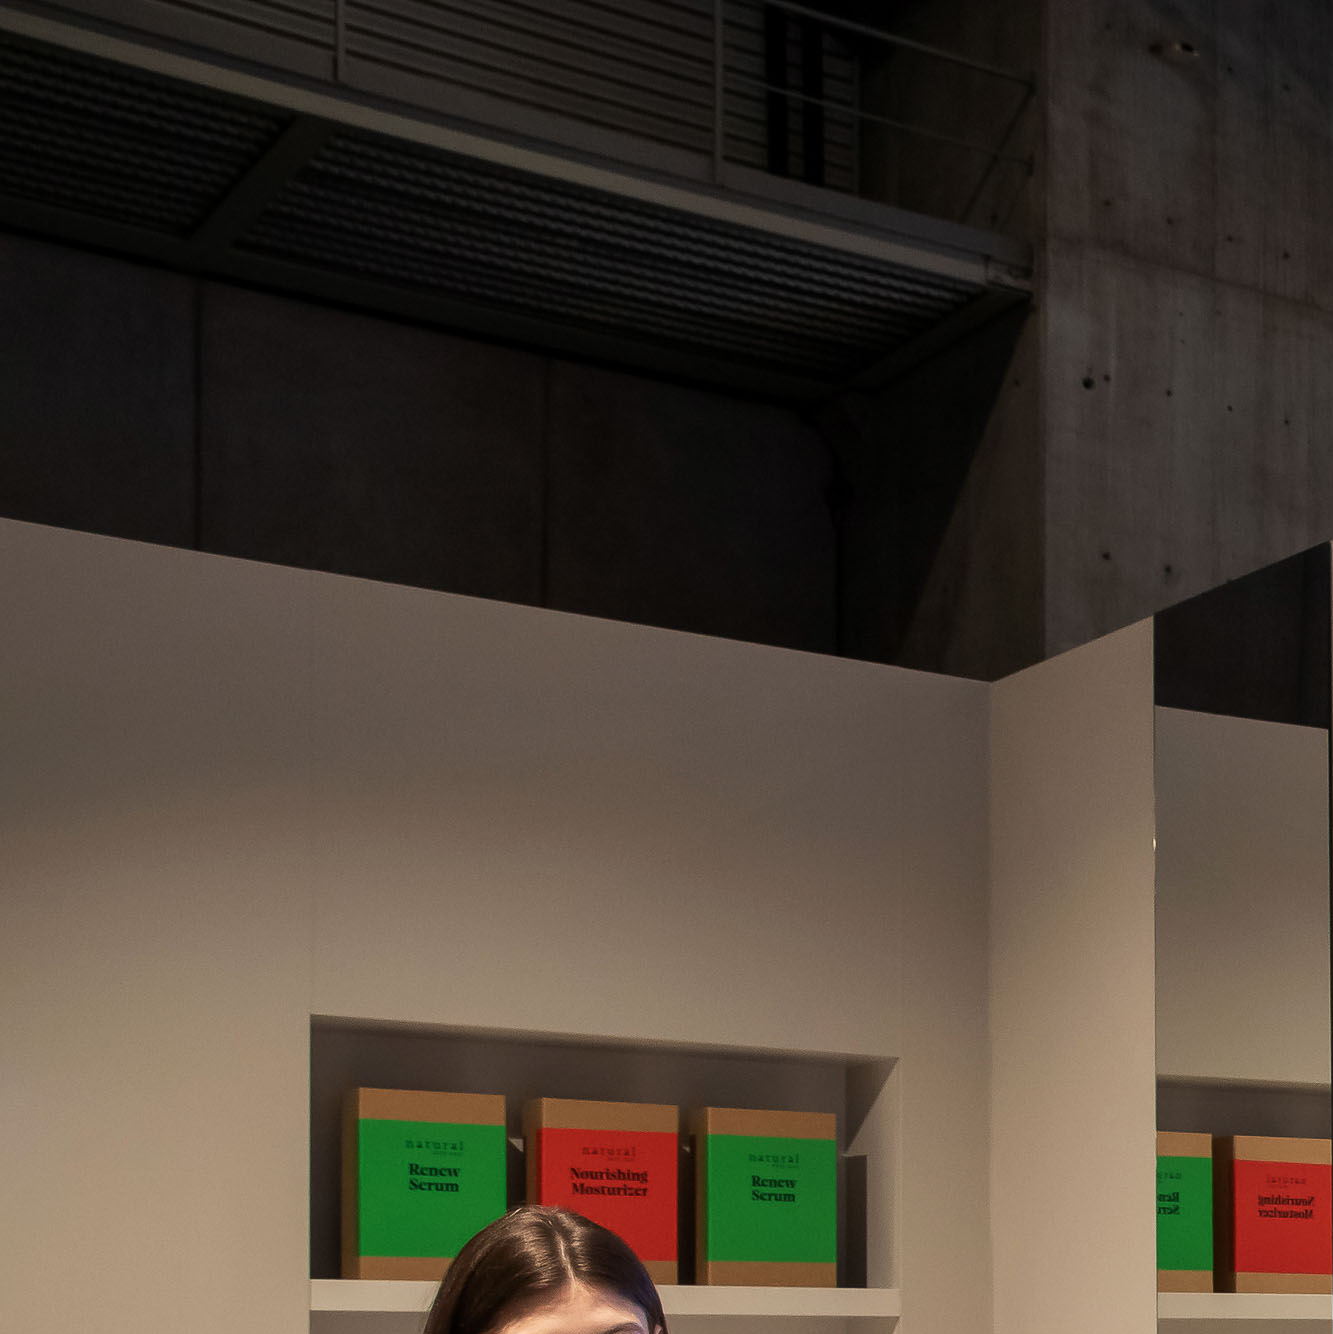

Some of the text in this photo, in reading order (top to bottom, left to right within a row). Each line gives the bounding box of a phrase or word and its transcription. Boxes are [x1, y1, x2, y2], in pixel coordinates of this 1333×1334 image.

[408, 1162, 461, 1177] Renew
[570, 1167, 649, 1183] Nourishing
[408, 1178, 460, 1192] Serum
[751, 1175, 797, 1188] Renew
[751, 1189, 796, 1202] Serum
